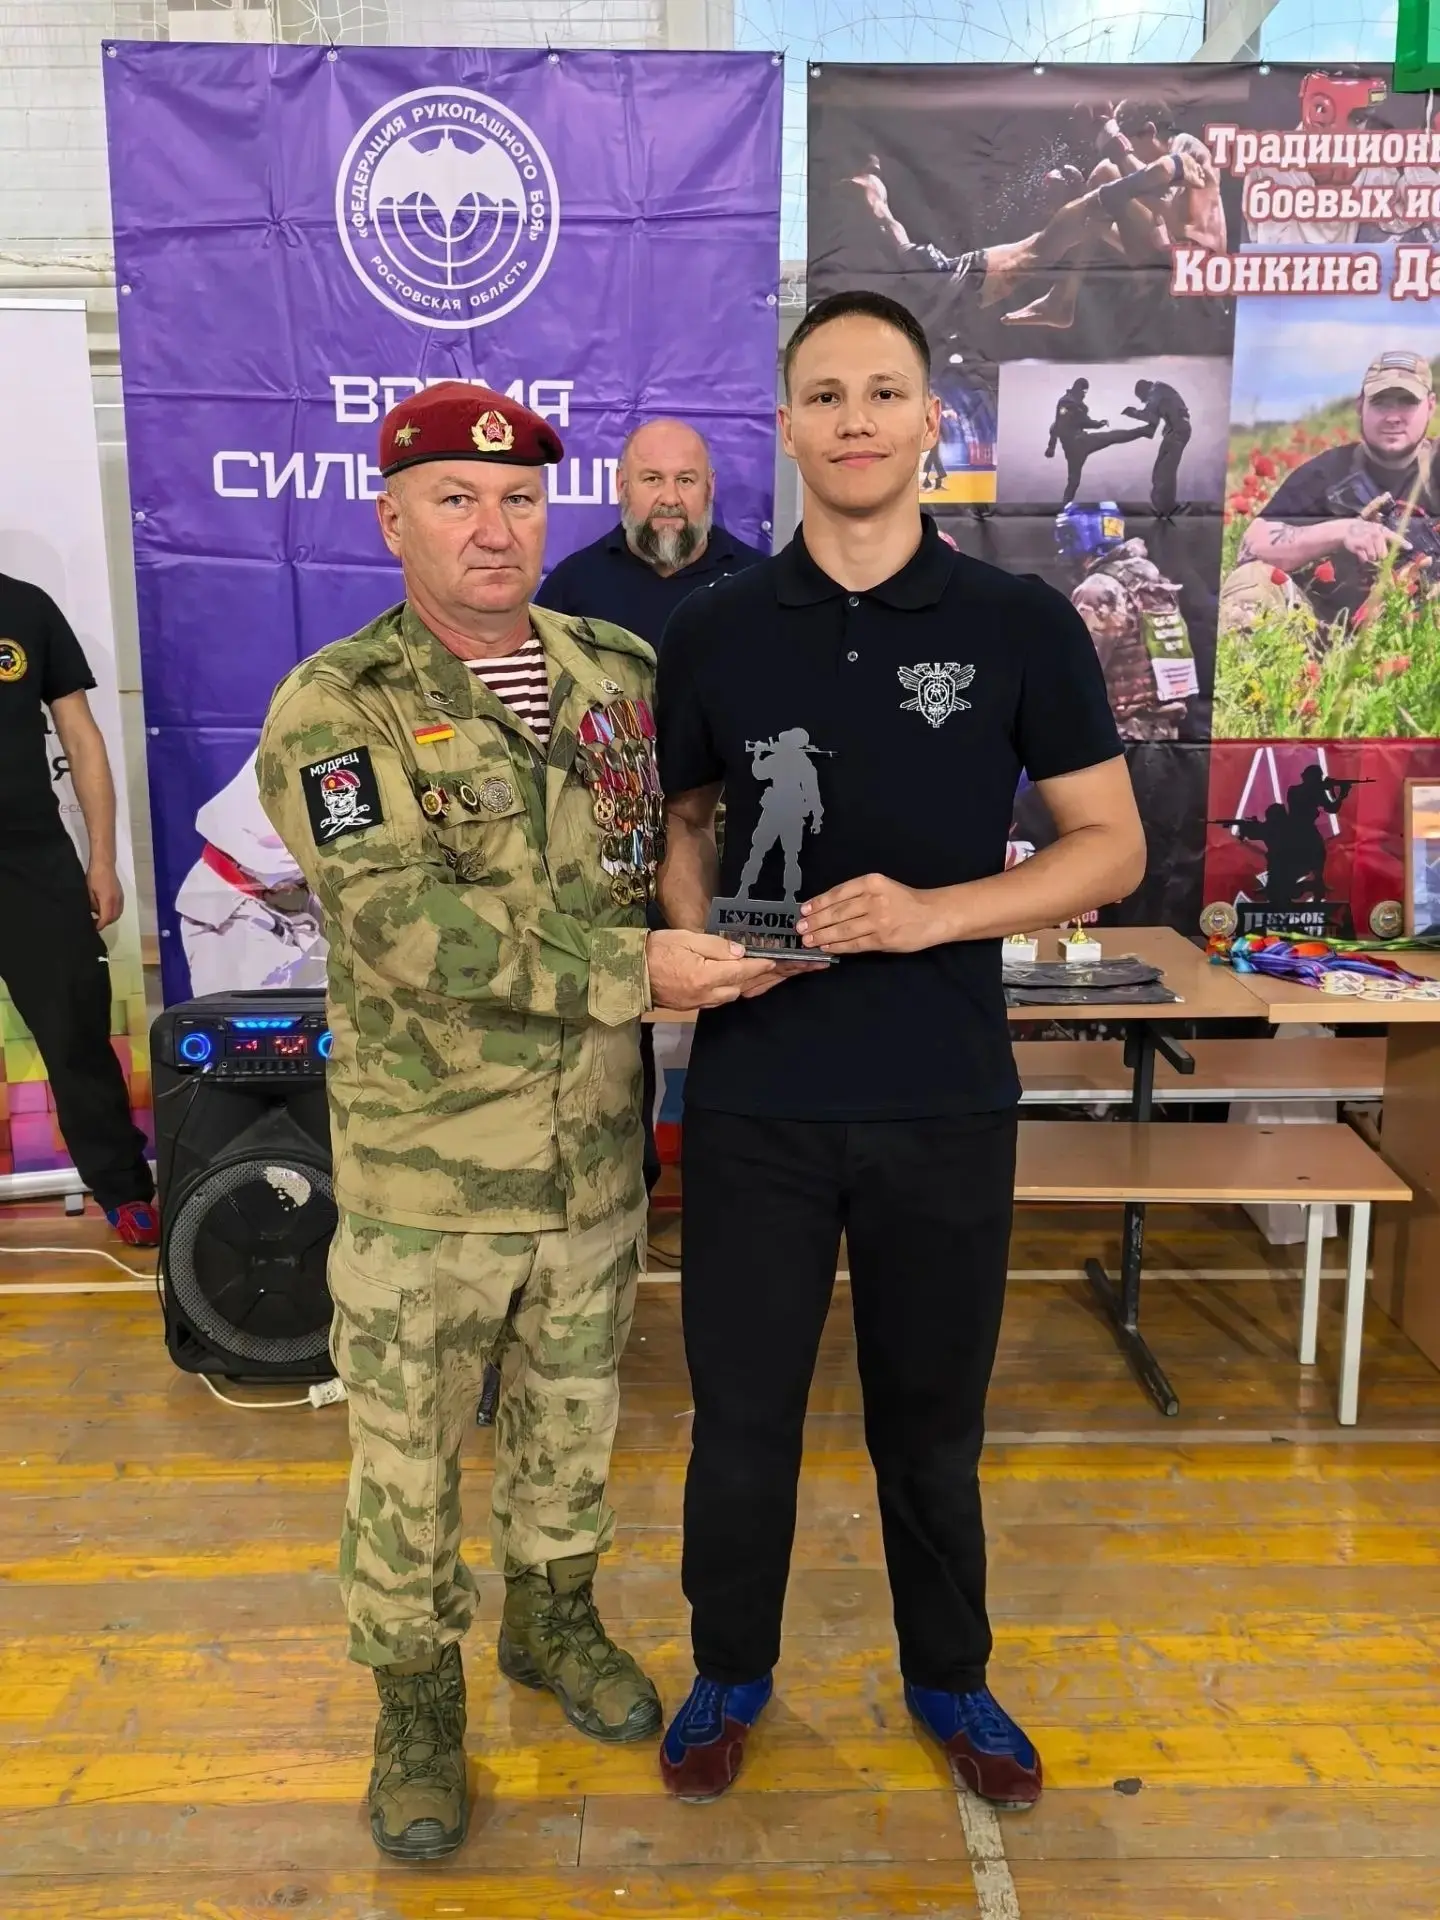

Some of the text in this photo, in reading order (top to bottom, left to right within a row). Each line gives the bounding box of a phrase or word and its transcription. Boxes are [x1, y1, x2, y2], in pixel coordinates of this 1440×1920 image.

[351, 102, 545, 241] «ФЕДЕРАЦИЯ РУКОПАШНОГО БОЯ»
[1250, 180, 1394, 219] боевых
[370, 255, 528, 310] РОСТОВСКАЯ ОБЛАСТЬ
[1173, 249, 1379, 292] Конкина
[310, 752, 359, 777] МУДРЕЦ
[718, 909, 795, 928] КУБОК
